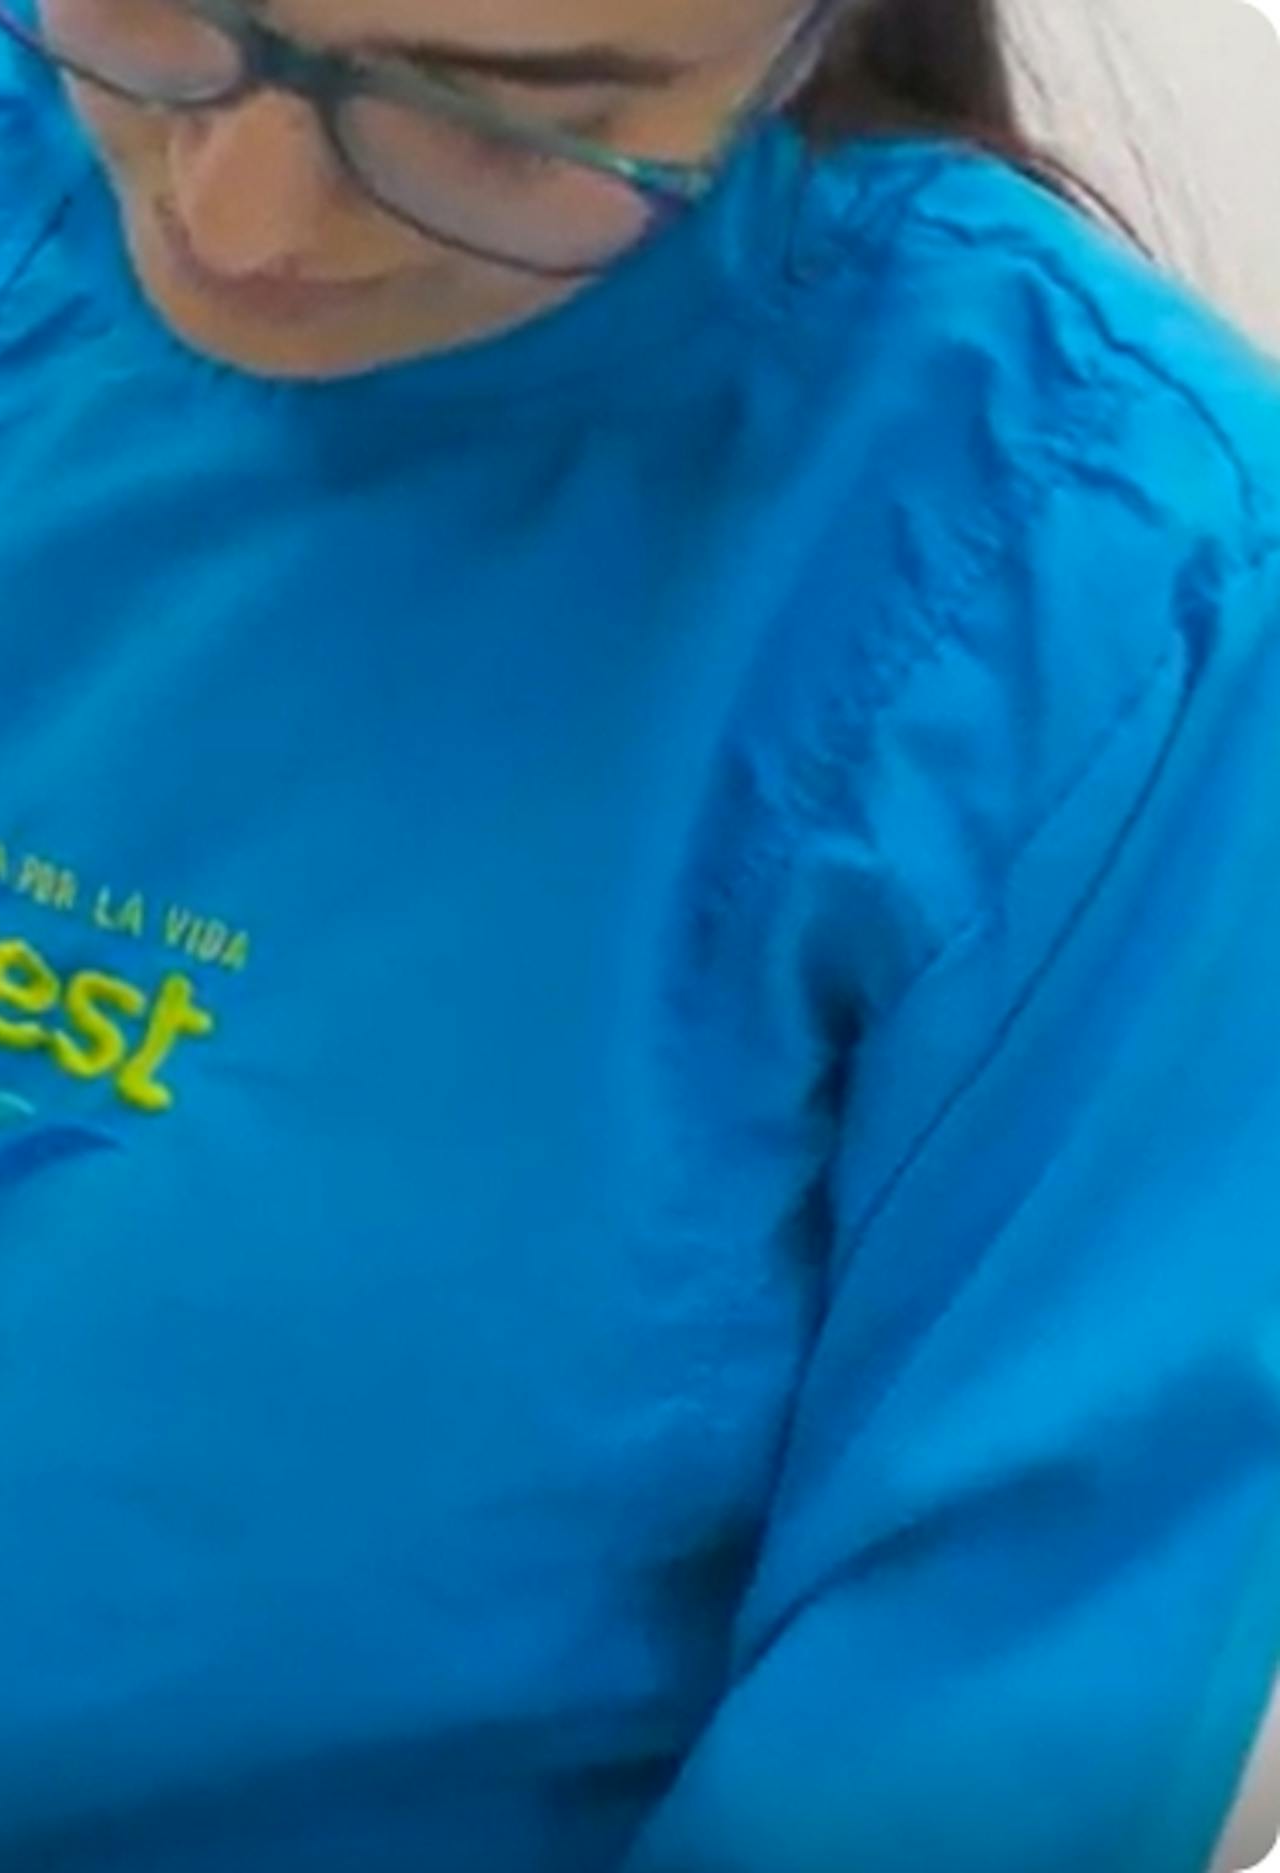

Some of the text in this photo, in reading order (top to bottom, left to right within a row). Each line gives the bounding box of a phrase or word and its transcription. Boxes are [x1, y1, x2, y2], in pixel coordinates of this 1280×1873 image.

[16, 854, 77, 910] POR
[92, 884, 144, 937] LA
[164, 904, 249, 971] VIDA
